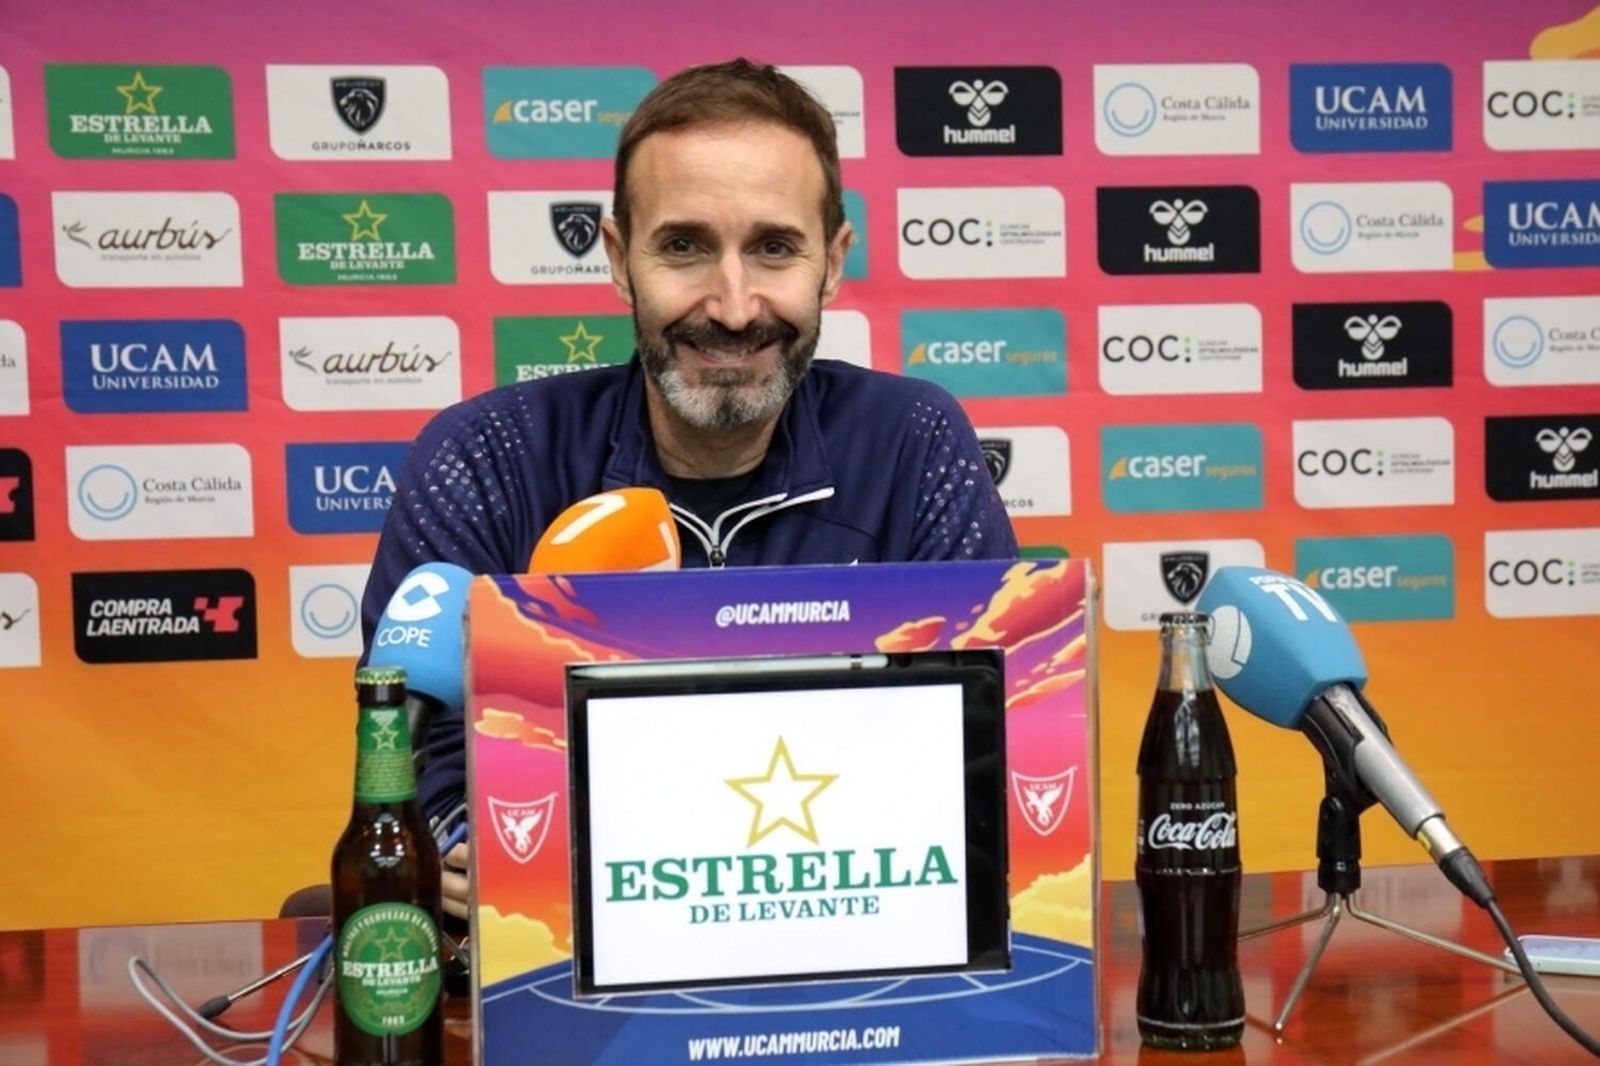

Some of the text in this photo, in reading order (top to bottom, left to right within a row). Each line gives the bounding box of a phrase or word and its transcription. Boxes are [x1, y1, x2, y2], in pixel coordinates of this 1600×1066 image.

[1161, 95, 1250, 110] Costa Cálida
[1314, 85, 1427, 114] UCAM
[513, 99, 598, 123] caser
[69, 115, 213, 133] ESTRELLA
[1315, 115, 1429, 130] UNIVERSIDAD
[104, 133, 182, 143] DE LEVANTE
[943, 124, 1016, 144] hummel
[1356, 212, 1444, 227] Costa Cálida
[97, 217, 233, 250] aurbús
[1508, 231, 1600, 247] UNIVERSID
[297, 242, 435, 260] ESTRELLA
[1143, 243, 1214, 263] hummel
[330, 260, 405, 270] DE LEVANTE
[530, 264, 610, 275] GRUPOMARC
[90, 343, 218, 373] UCAM
[322, 341, 453, 374] aurbús
[927, 340, 1007, 364] caser
[1337, 357, 1408, 378] hummel
[92, 374, 220, 390] UNIVERSIDAD
[1128, 454, 1207, 478] caser
[142, 476, 242, 493] Costa Cálida
[314, 464, 397, 494] UCA
[1529, 468, 1599, 490] hummel
[315, 496, 393, 511] UNIVERS
[1320, 565, 1398, 590] caser
[89, 598, 173, 618] COMPRA
[715, 600, 850, 627] @UCAMMURCIA
[86, 615, 200, 637] LAENTRADA
[377, 625, 433, 648] COPE
[1169, 802, 1193, 810] ZERO
[1148, 812, 1237, 851] Coca-Cola
[605, 845, 959, 902] ESTRELLA
[688, 895, 881, 925] DE LEVANTE
[342, 956, 439, 979] ESTRELLA
[688, 1026, 901, 1061] WWW.UCAMMURCIA.COM
